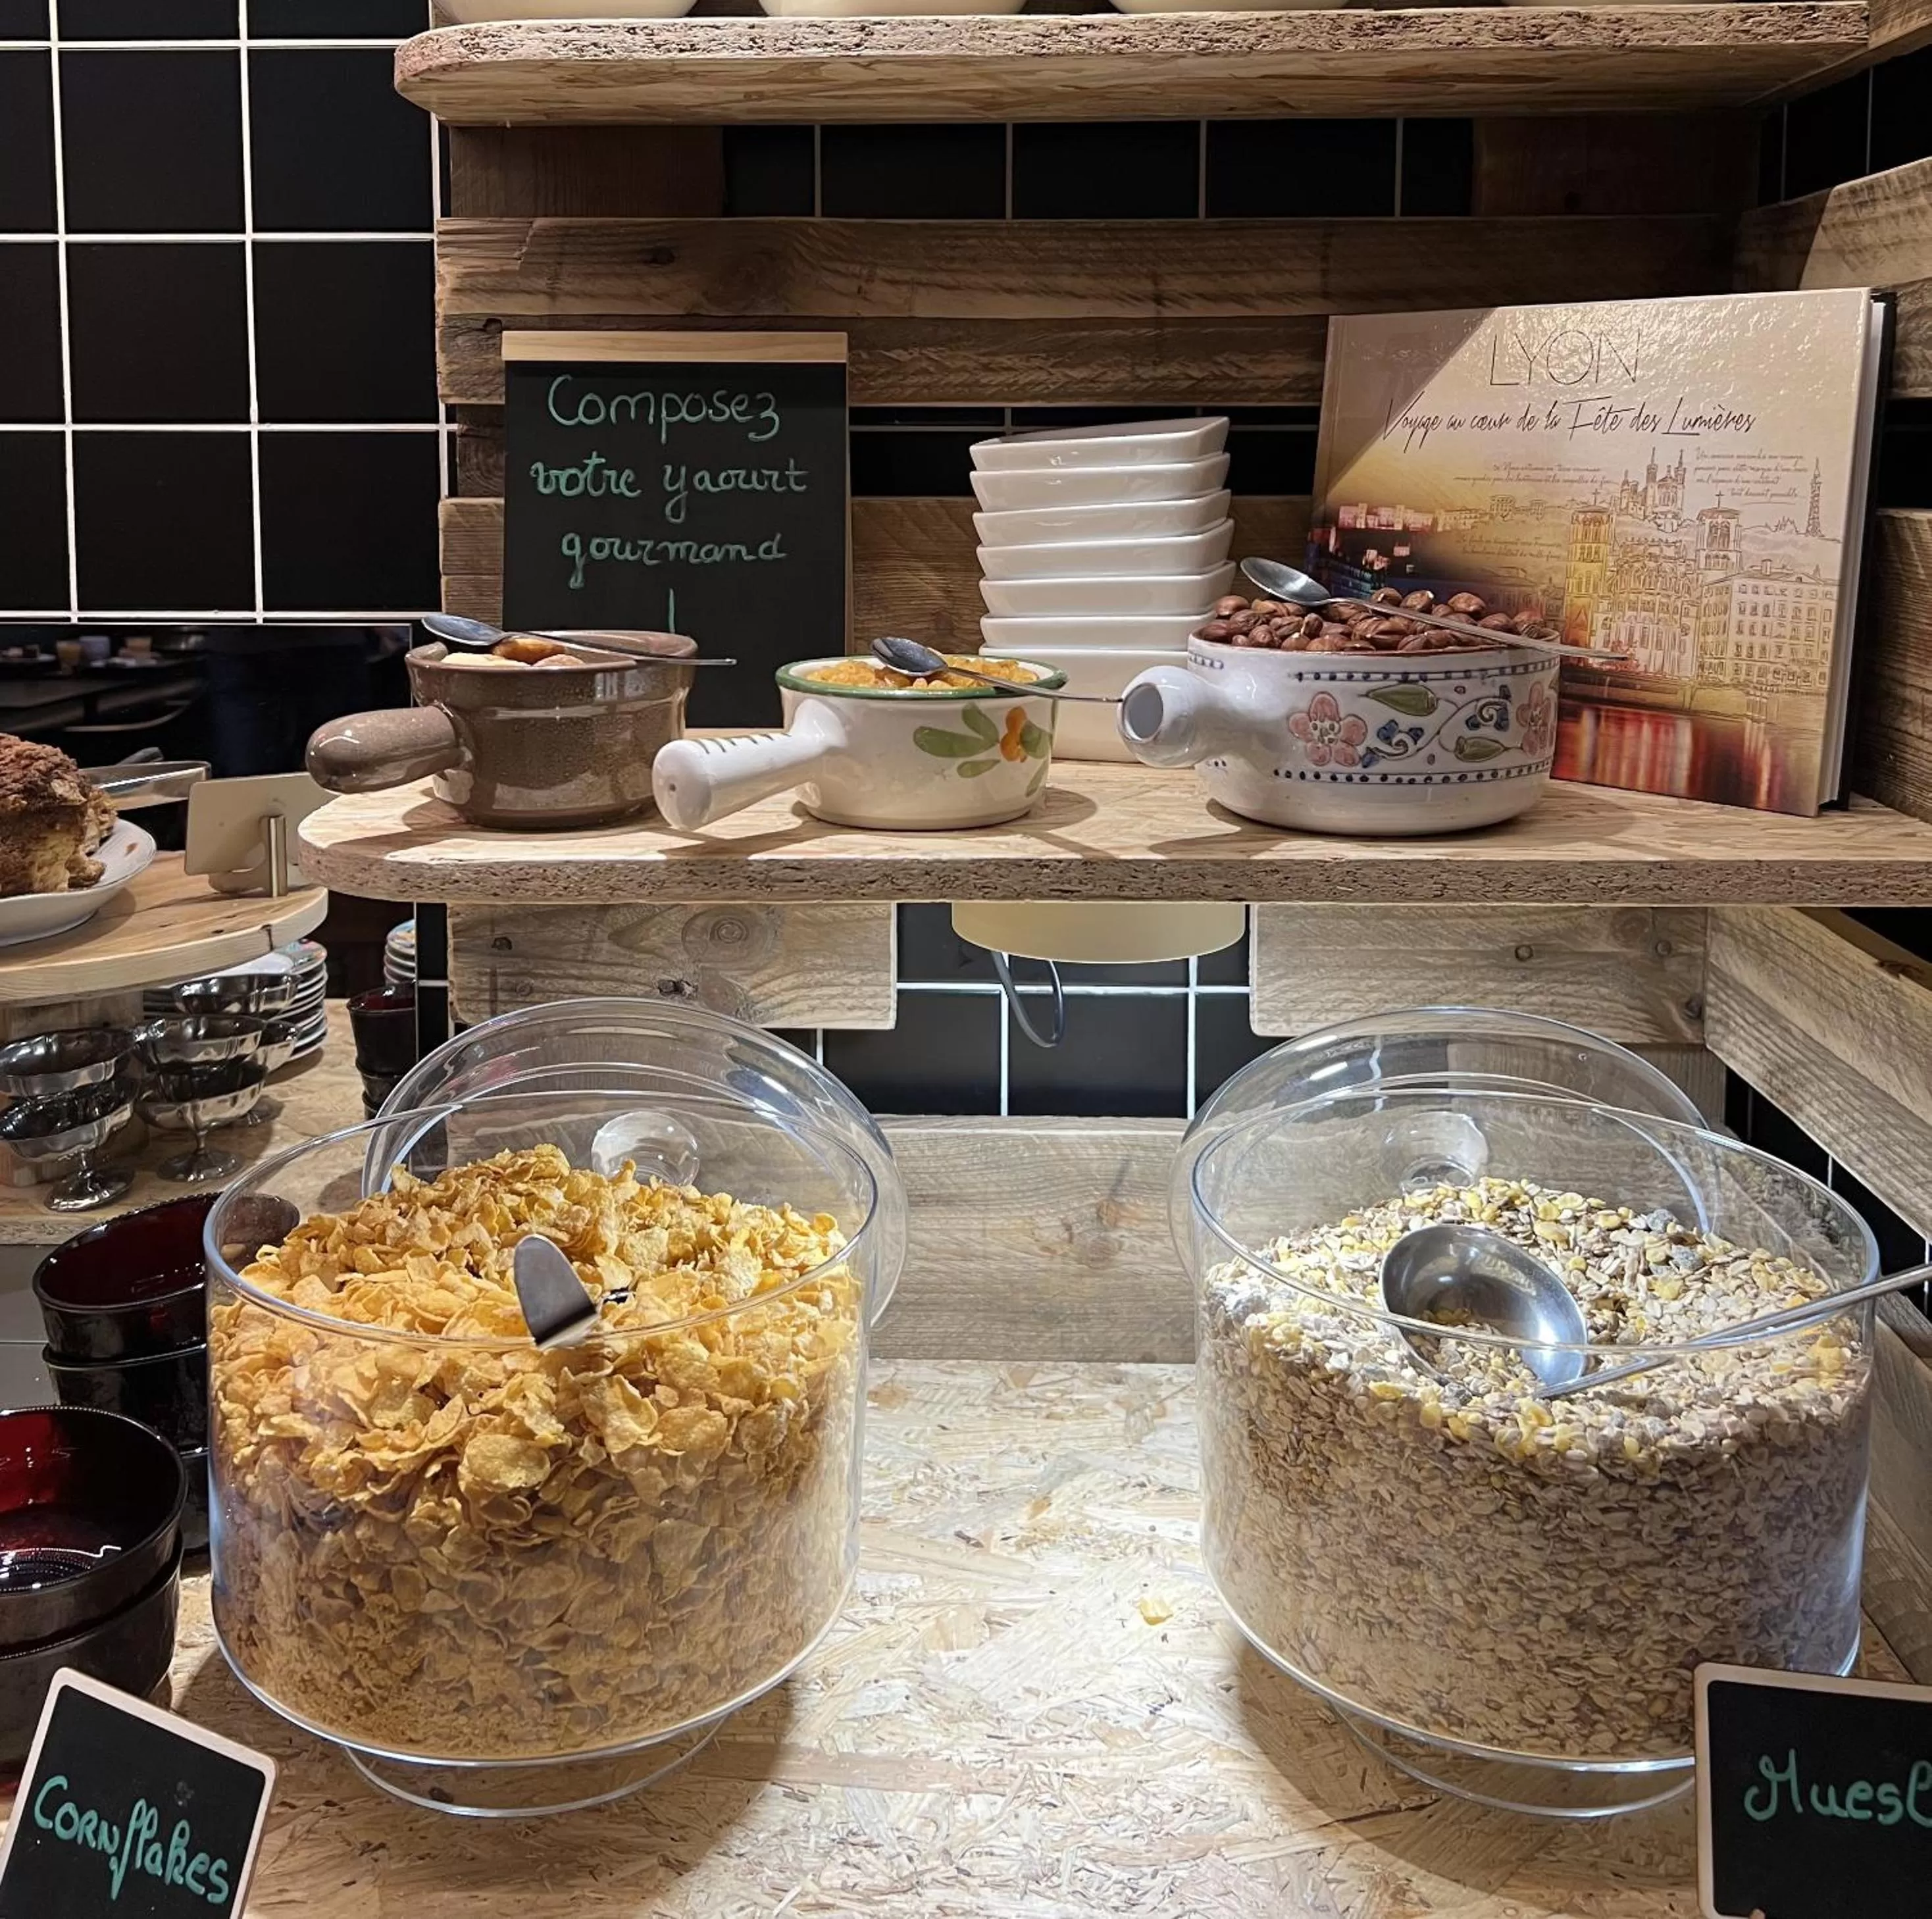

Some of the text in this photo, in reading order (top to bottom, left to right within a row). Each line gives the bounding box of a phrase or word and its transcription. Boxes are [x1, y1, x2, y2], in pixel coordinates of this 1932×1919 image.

[1490, 328, 1640, 385] LYON
[547, 374, 781, 444] Composez
[1383, 390, 1442, 453] Voyage
[1446, 414, 1465, 430] au
[1516, 403, 1538, 432] de
[1544, 399, 1562, 431] la
[1562, 396, 1635, 440] Fête
[1629, 401, 1662, 432] des
[1660, 396, 1757, 436] Lumières
[530, 450, 809, 523] votre yaourt
[561, 532, 787, 589] gourmand
